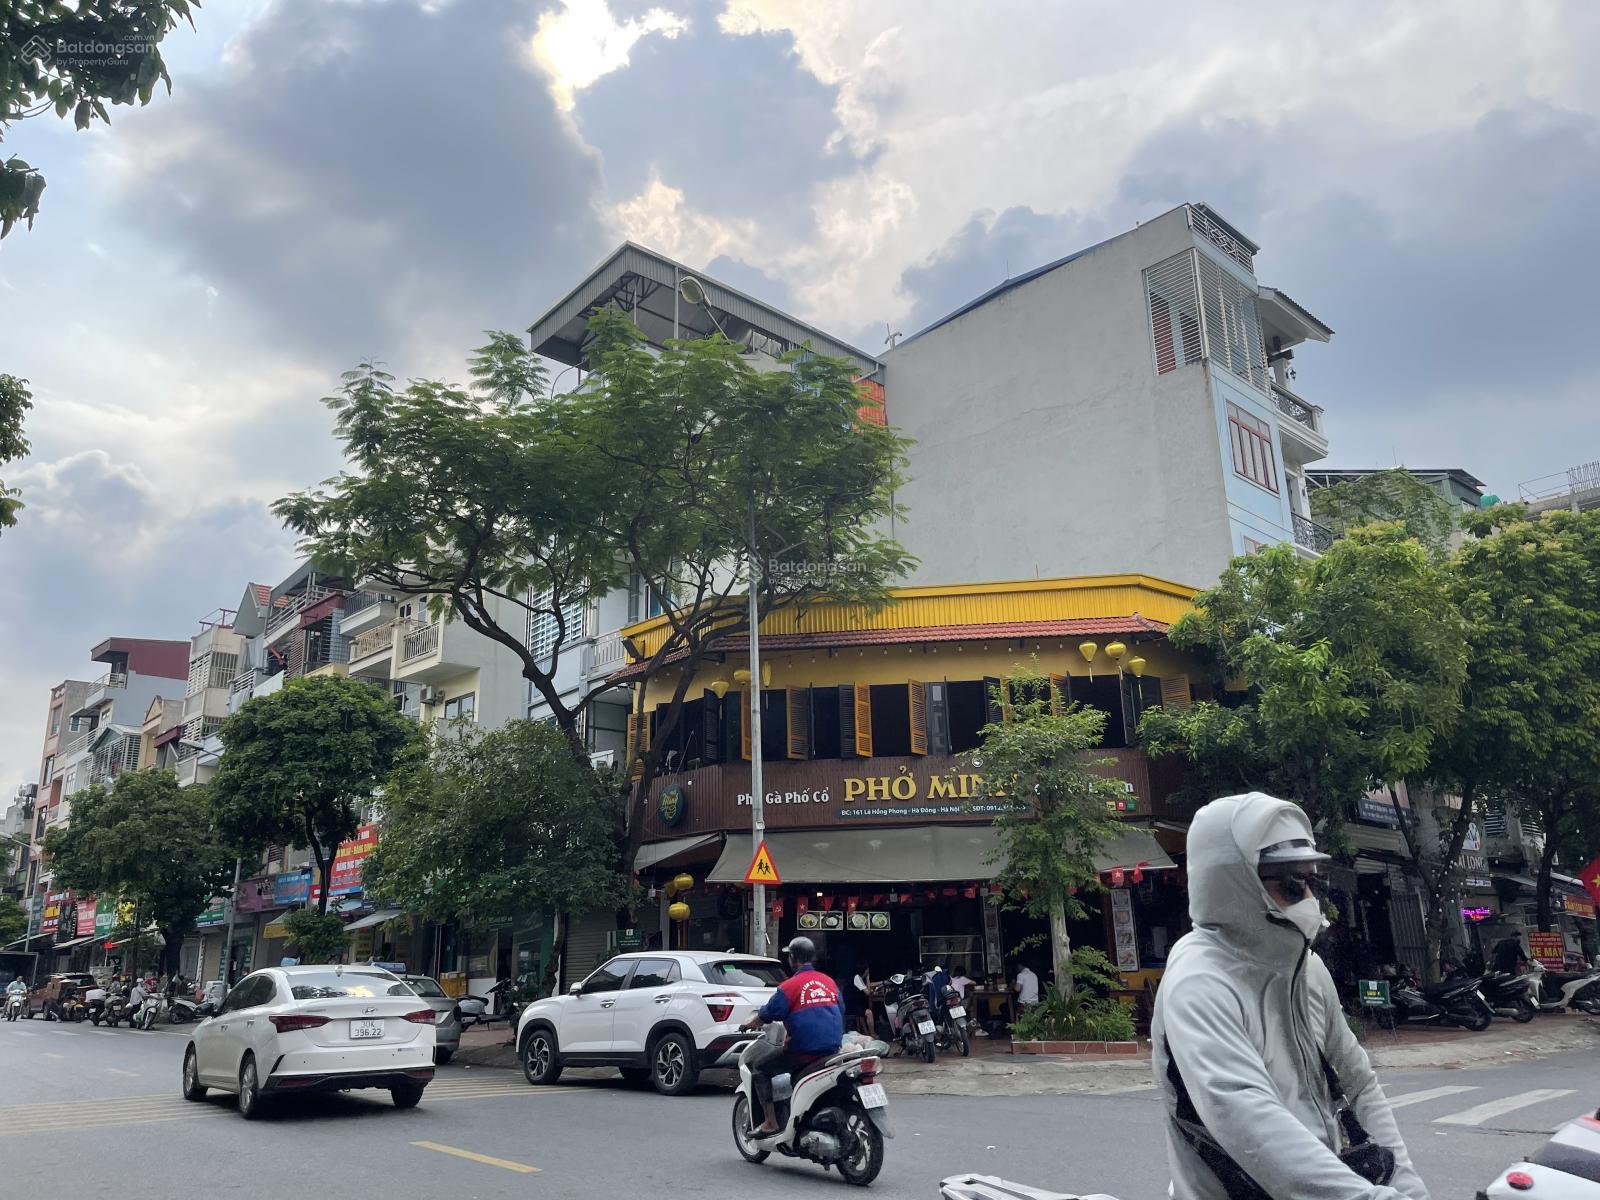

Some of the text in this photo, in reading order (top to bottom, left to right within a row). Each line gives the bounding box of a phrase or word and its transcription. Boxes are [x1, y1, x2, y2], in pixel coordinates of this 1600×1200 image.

[844, 766, 916, 801] PHỞ
[927, 773, 1018, 799] MIN
[737, 787, 829, 805] Ph Gà Phố Cổ
[872, 808, 887, 816] Hồng
[1531, 947, 1542, 957] XE
[361, 1020, 375, 1028] 30K
[354, 1028, 382, 1037] 396.22
